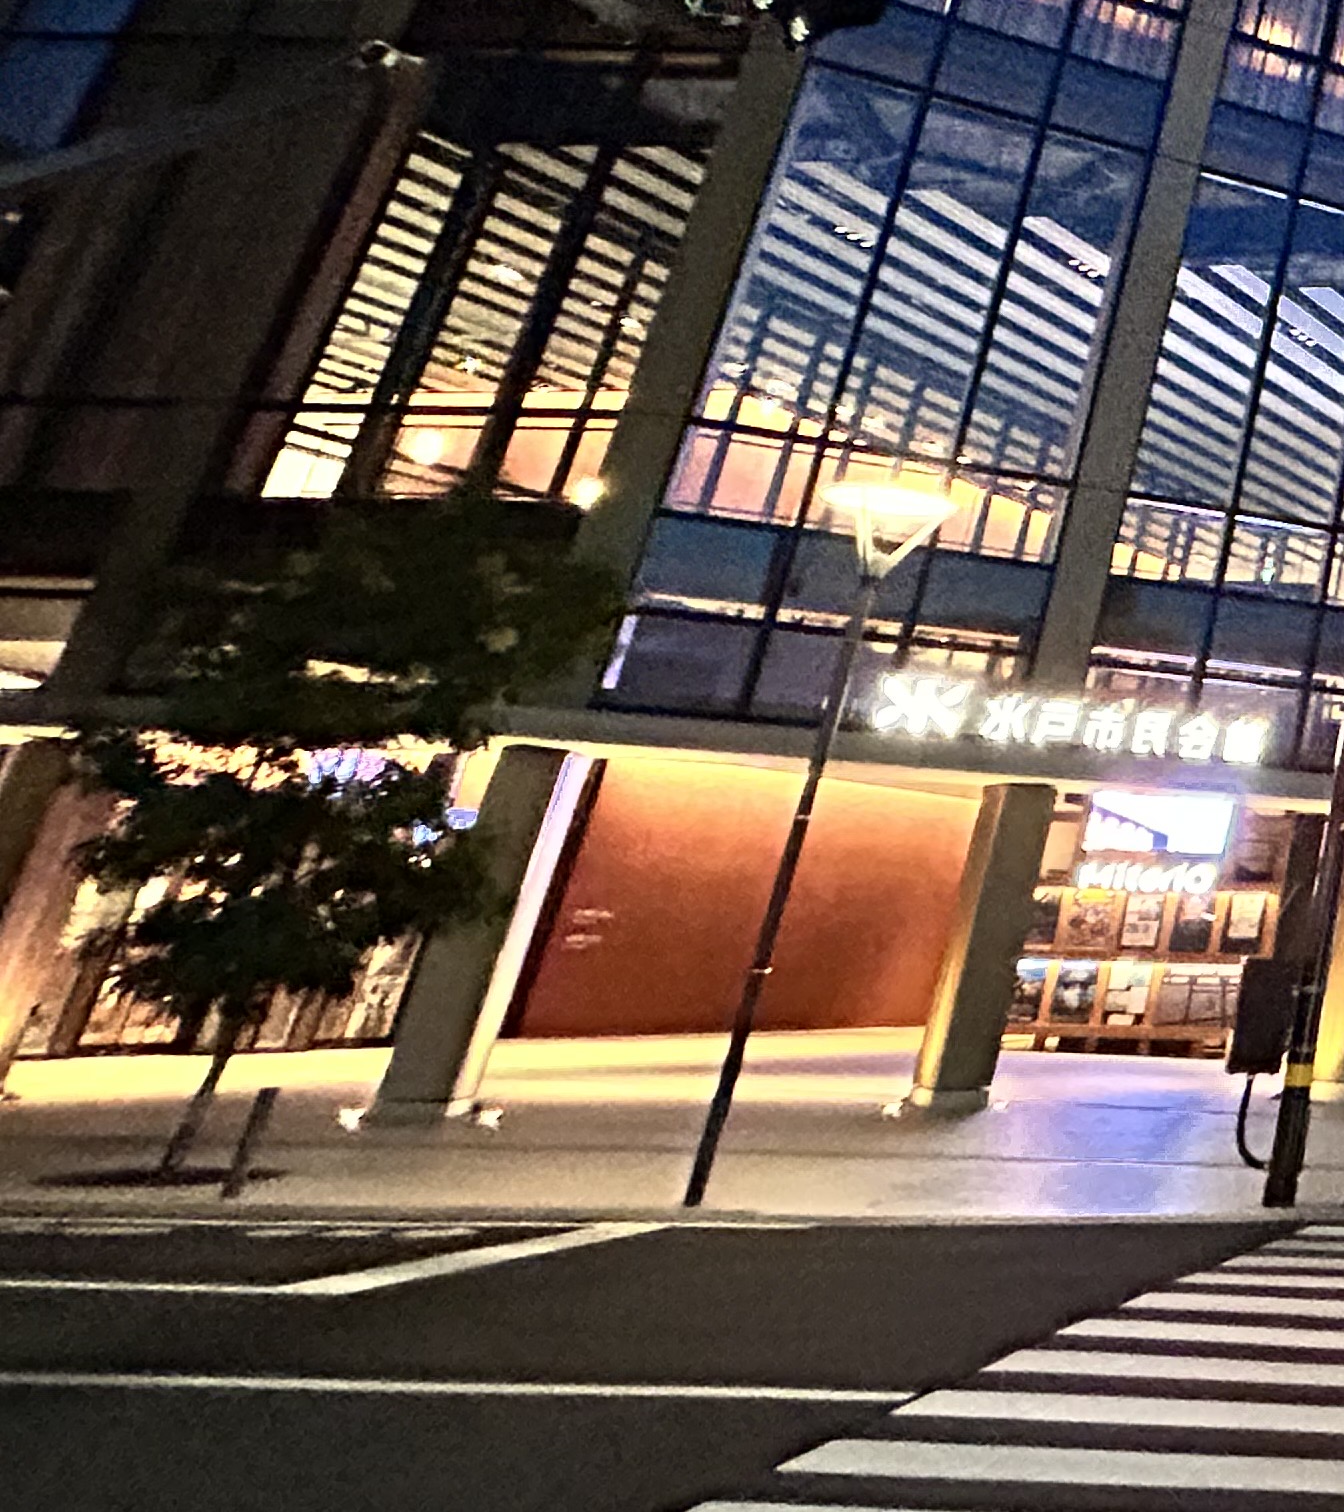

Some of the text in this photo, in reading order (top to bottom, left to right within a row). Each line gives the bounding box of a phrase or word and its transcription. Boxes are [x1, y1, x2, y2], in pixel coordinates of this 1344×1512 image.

[978, 694, 1269, 763] 水戸市民会館
